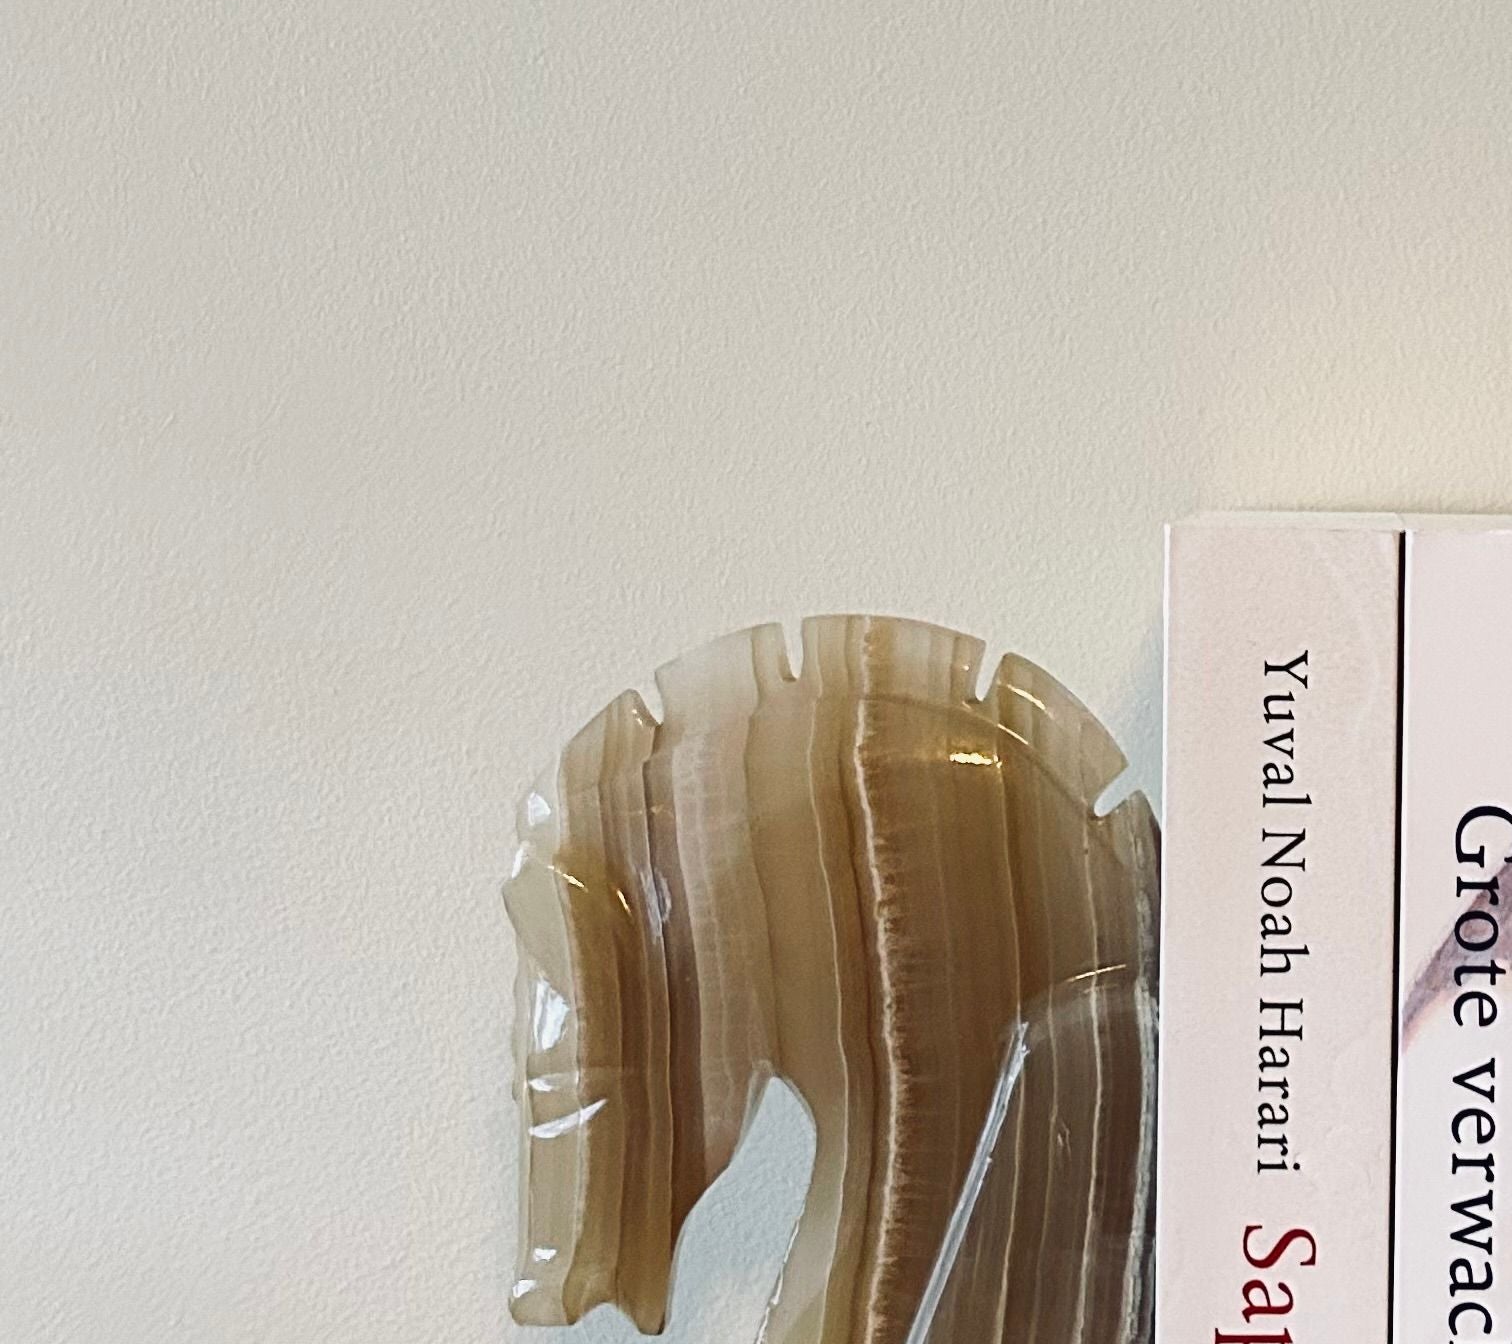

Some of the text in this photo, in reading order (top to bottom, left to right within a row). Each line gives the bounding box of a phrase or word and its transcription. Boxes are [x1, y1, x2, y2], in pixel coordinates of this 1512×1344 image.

[1257, 650, 1312, 1174] Yuval Noah Harari
